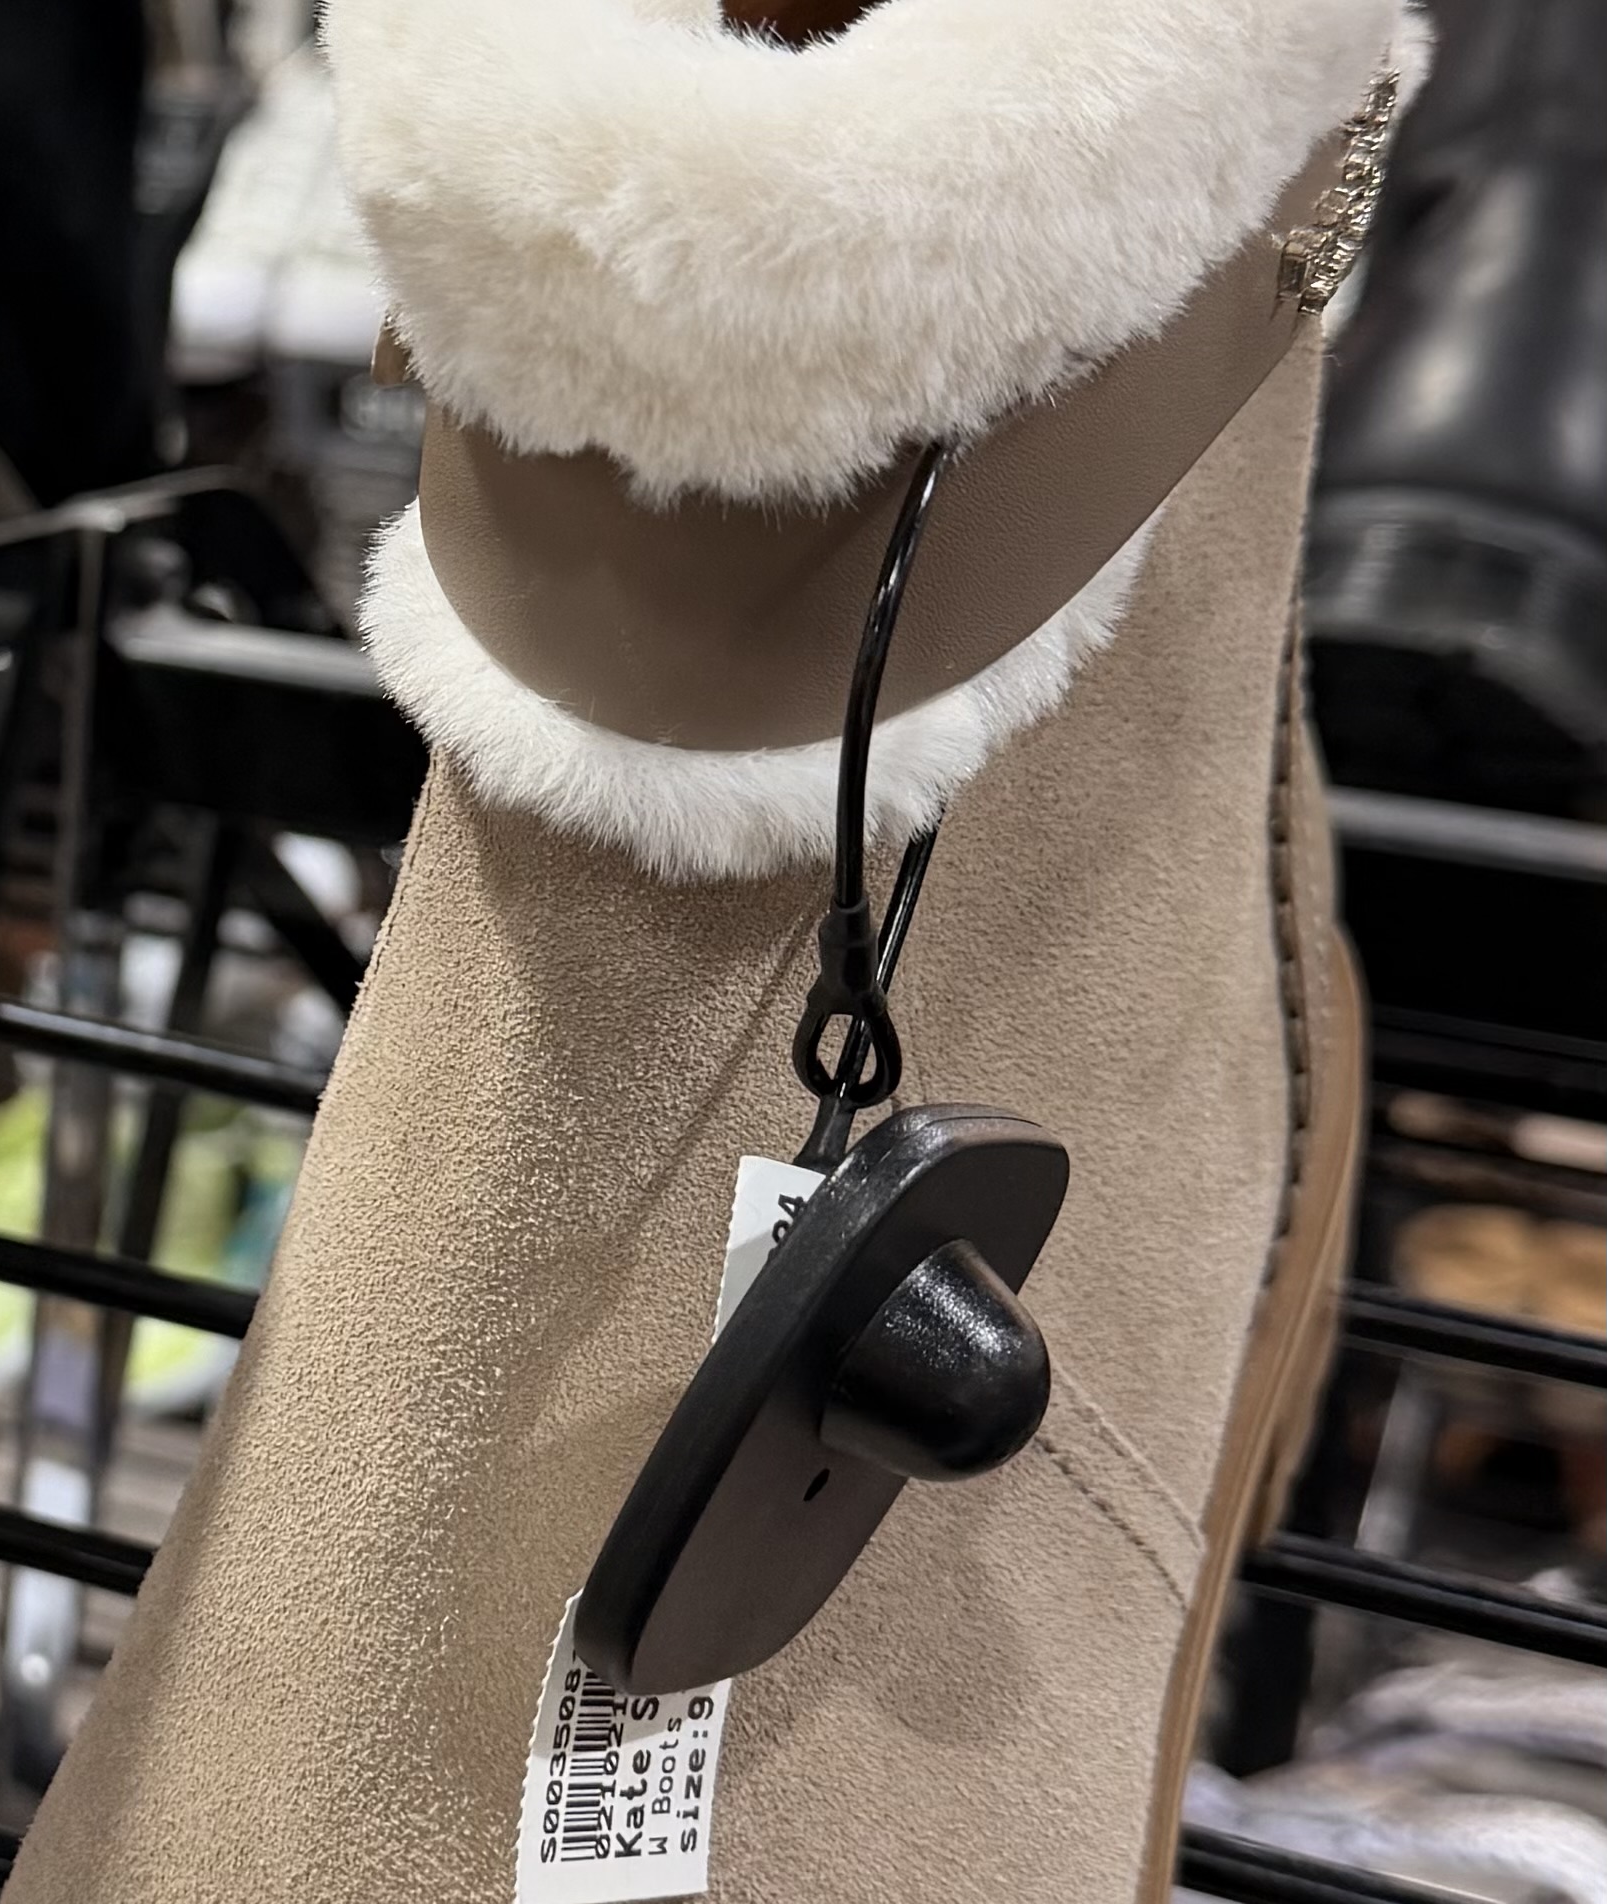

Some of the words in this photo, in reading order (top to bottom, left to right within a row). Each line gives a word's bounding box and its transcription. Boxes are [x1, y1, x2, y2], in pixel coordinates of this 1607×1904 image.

[540, 1649, 581, 1863] S003508
[614, 1749, 651, 1858] Kate
[651, 1717, 682, 1815] Boots
[648, 1836, 668, 1856] W
